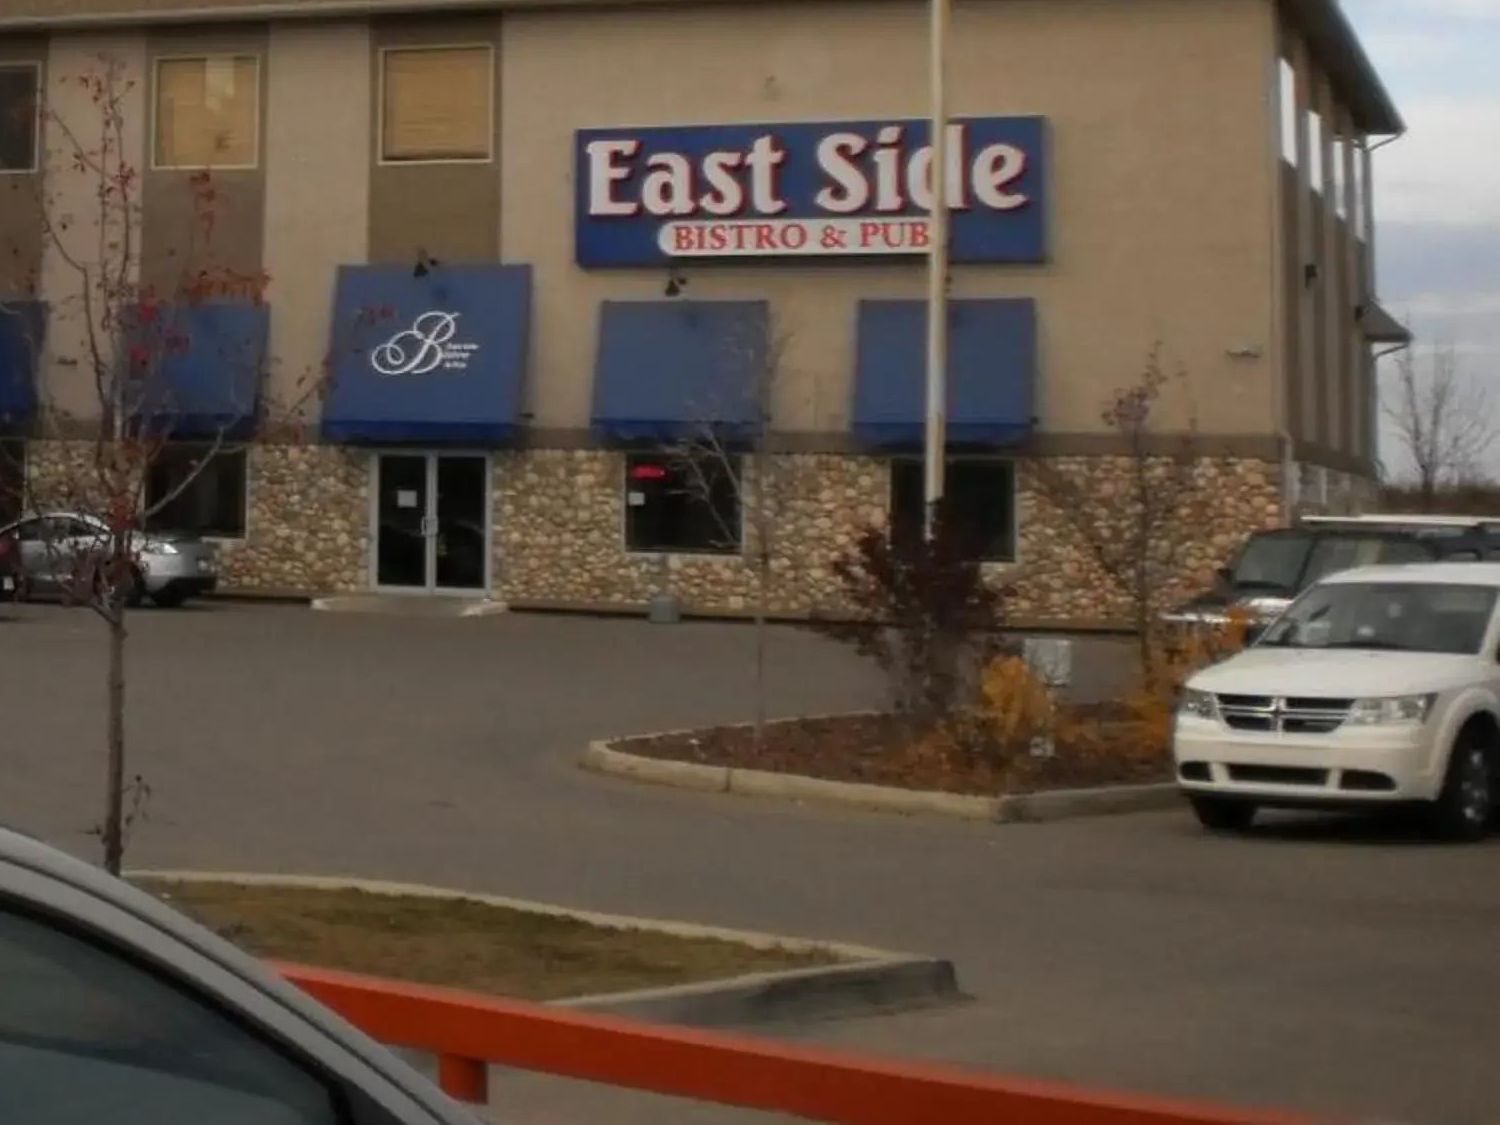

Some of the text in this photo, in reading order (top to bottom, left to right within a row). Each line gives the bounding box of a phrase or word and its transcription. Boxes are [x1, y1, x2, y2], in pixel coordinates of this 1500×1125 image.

[587, 123, 1028, 216] East Side
[673, 221, 930, 251] BISTRO & PUB
